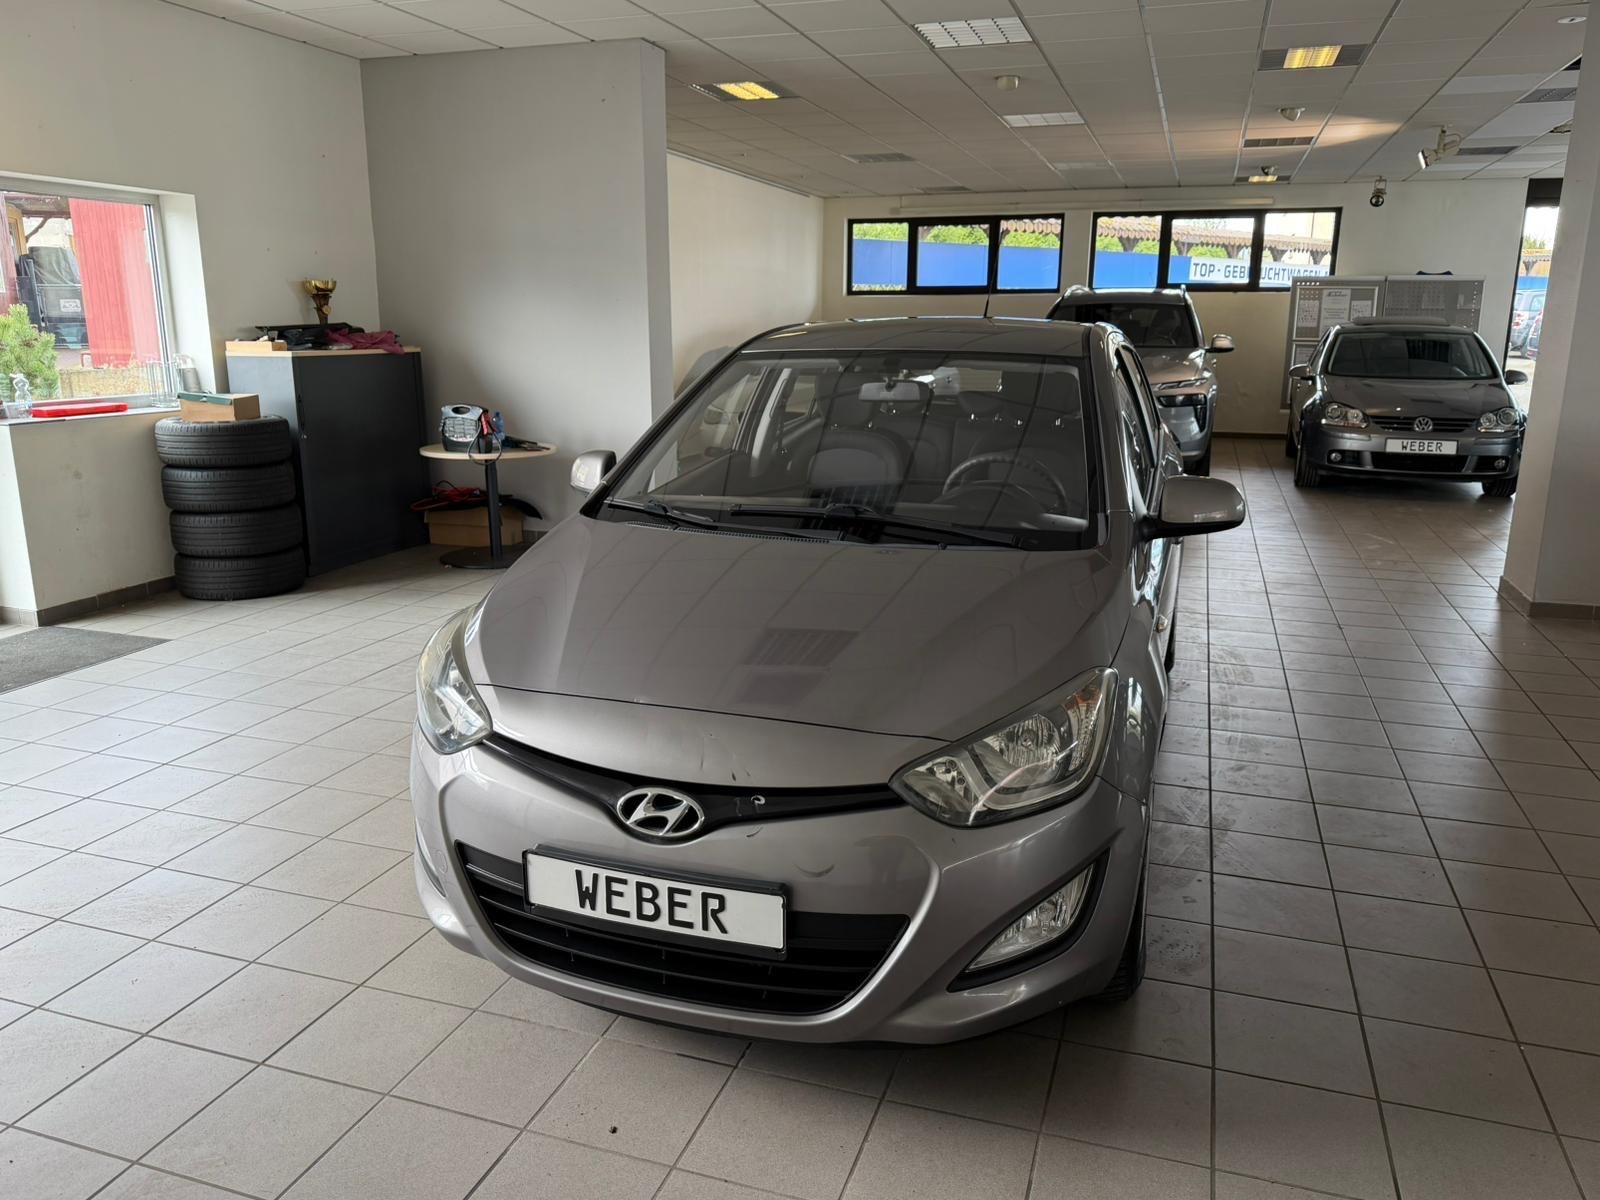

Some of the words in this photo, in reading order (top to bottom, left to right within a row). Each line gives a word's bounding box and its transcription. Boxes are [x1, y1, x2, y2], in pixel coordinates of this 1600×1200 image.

[1193, 263, 1216, 278] TOP
[1401, 441, 1443, 452] WEBER
[575, 869, 728, 934] WEBER
